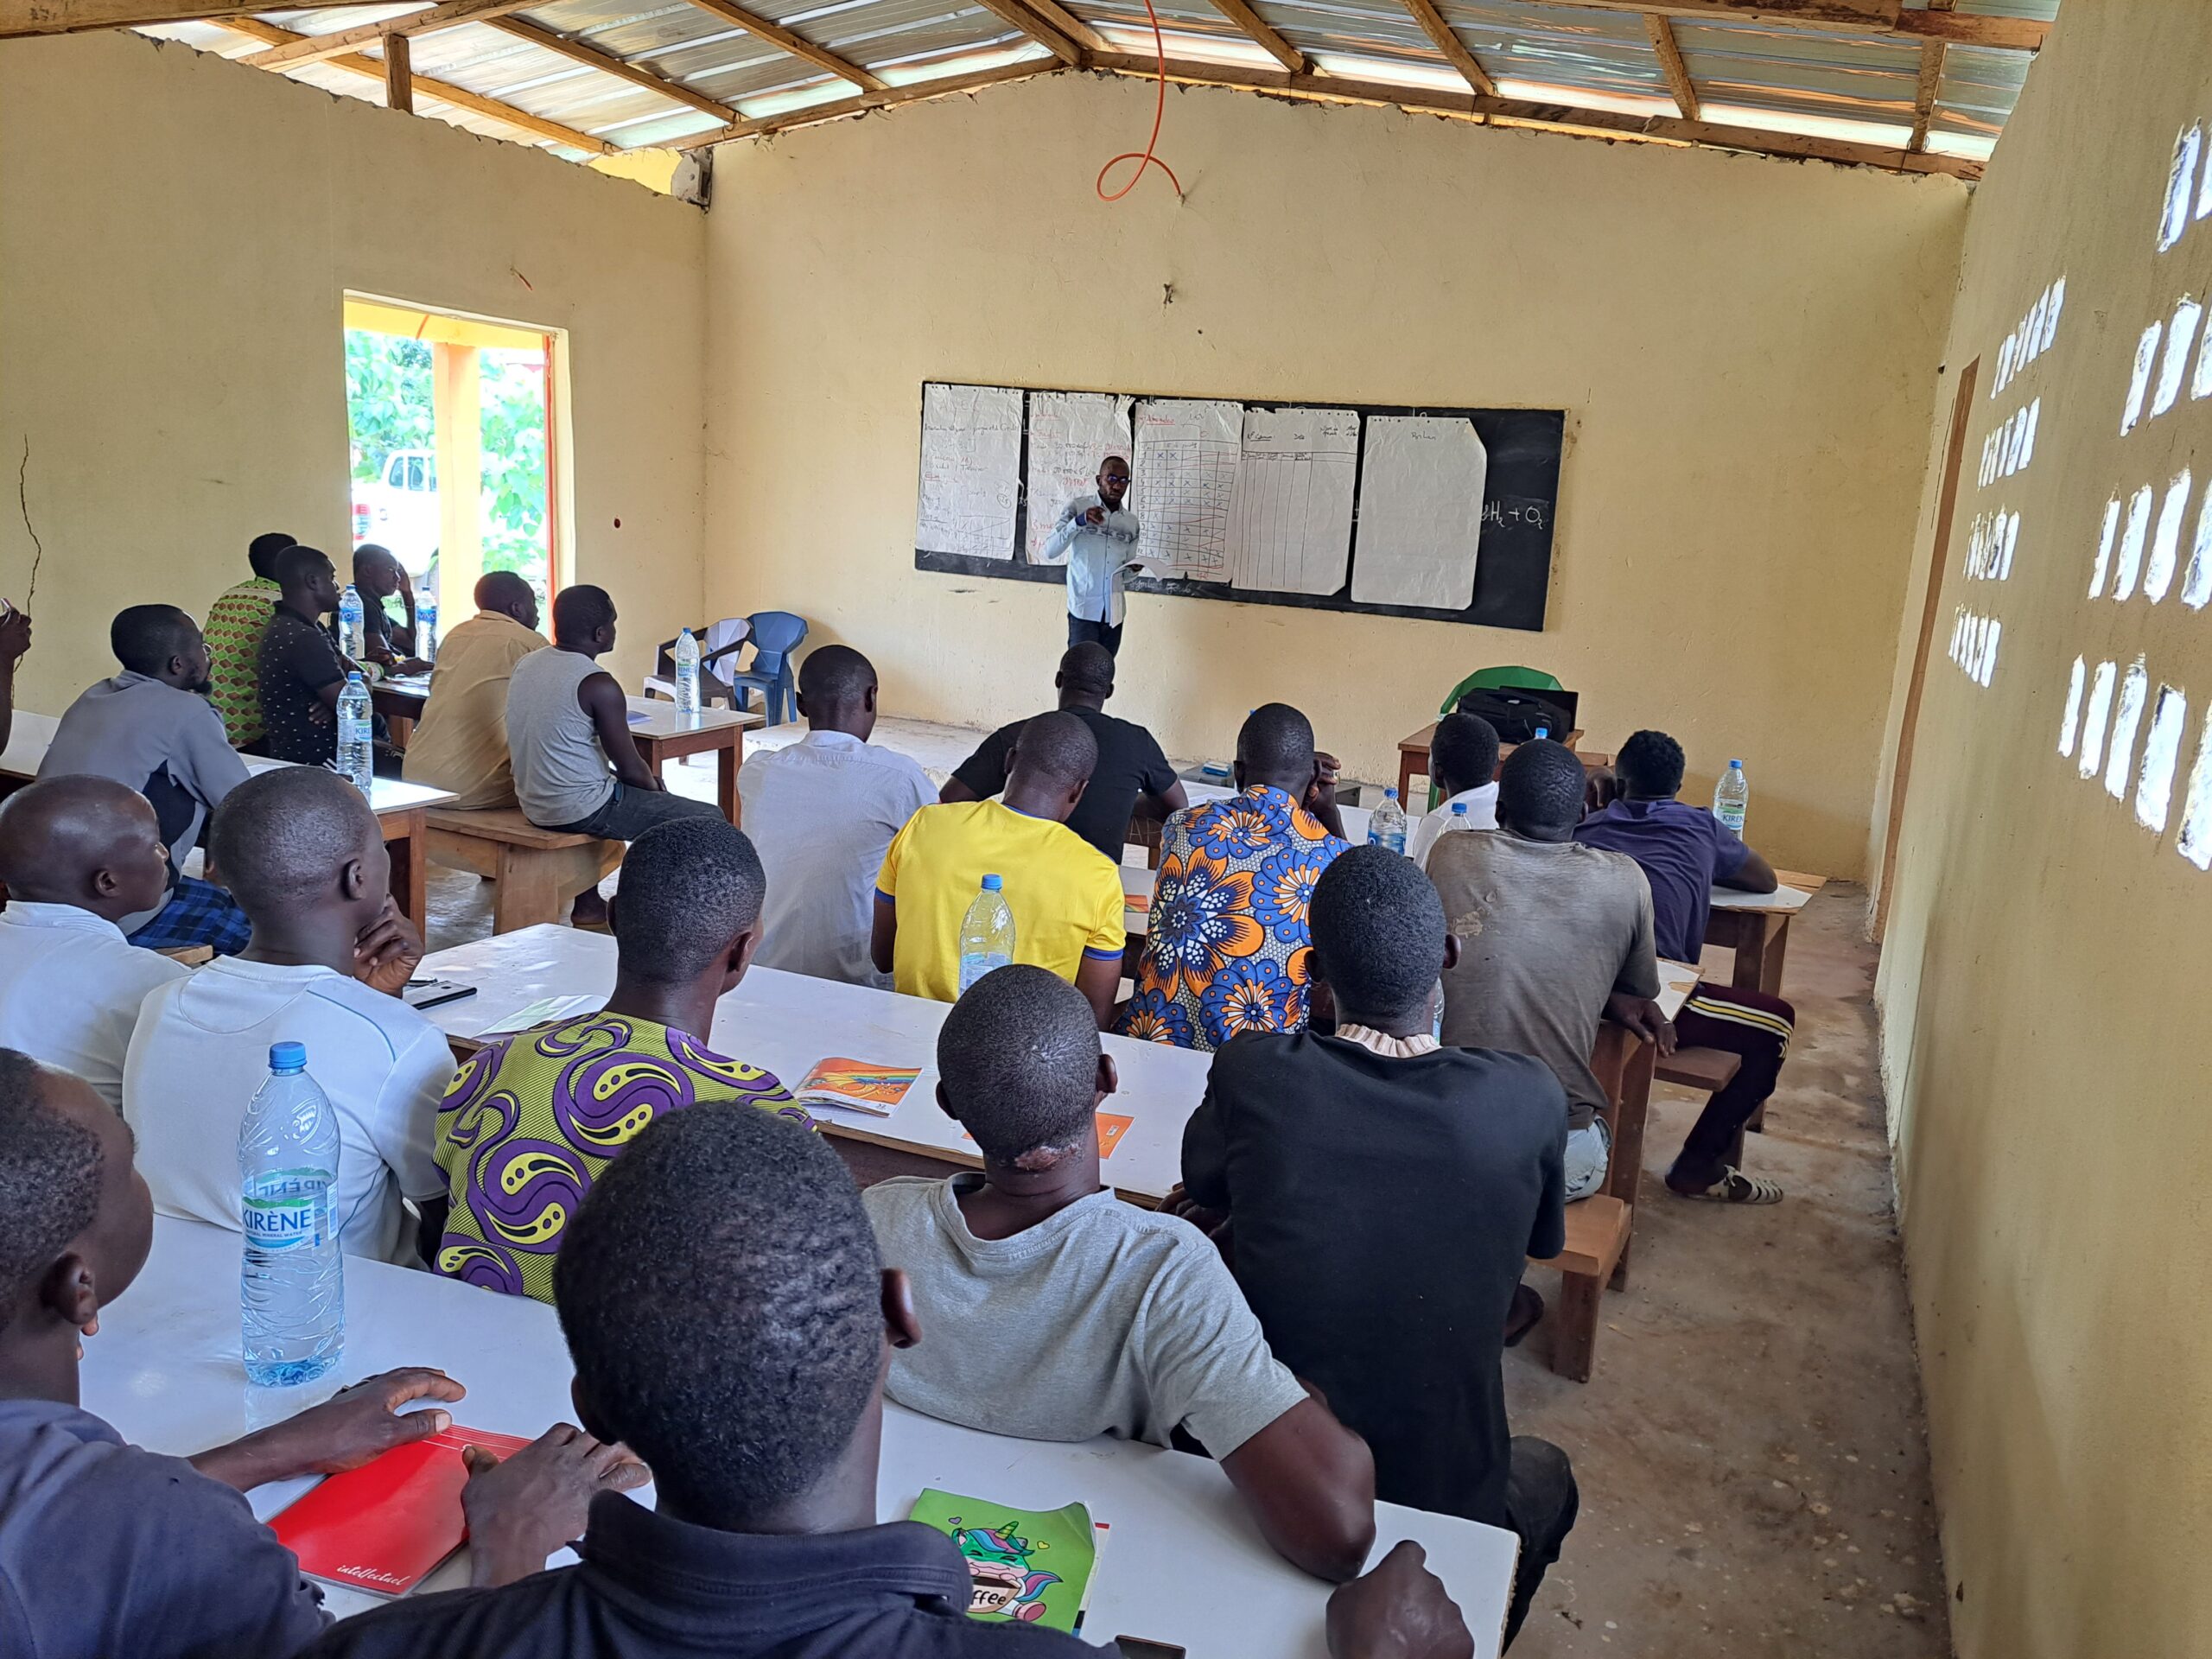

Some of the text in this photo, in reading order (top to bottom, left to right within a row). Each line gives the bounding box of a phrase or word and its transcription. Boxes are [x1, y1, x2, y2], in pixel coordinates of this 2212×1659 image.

[242, 1206, 312, 1232] KIRÈNE
[336, 1565, 411, 1586] intellectuel
[970, 1589, 1007, 1605] ffee
